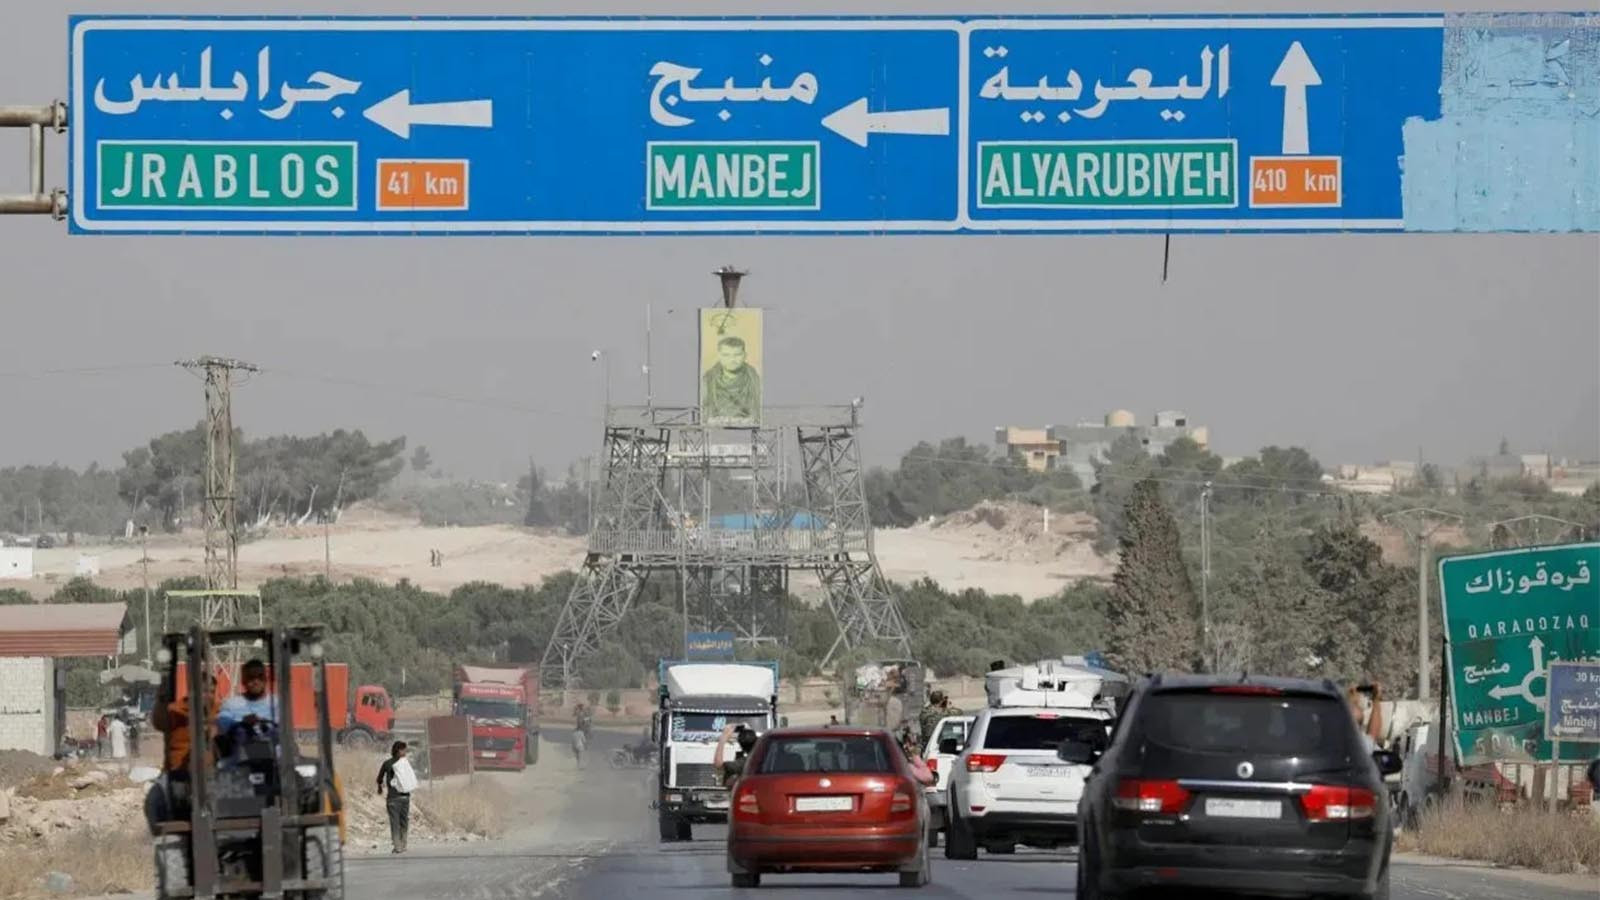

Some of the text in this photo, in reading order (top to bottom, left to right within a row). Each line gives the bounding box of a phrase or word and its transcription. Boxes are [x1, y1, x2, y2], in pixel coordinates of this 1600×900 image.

[94, 46, 362, 119] جرابلس
[650, 54, 819, 127] منبج
[979, 44, 1231, 122] اليعربية
[111, 151, 340, 199] JRABLOS
[387, 171, 459, 195] 41 km
[654, 152, 811, 199] MANBEJ
[984, 151, 1230, 197] ALYARUBIYEH
[1254, 168, 1336, 192] 410 km
[1468, 614, 1589, 640] QARAQOZAQ
[1463, 658, 1510, 684] منبج
[1575, 672, 1588, 683] 30
[1462, 706, 1519, 727] MANBEJ
